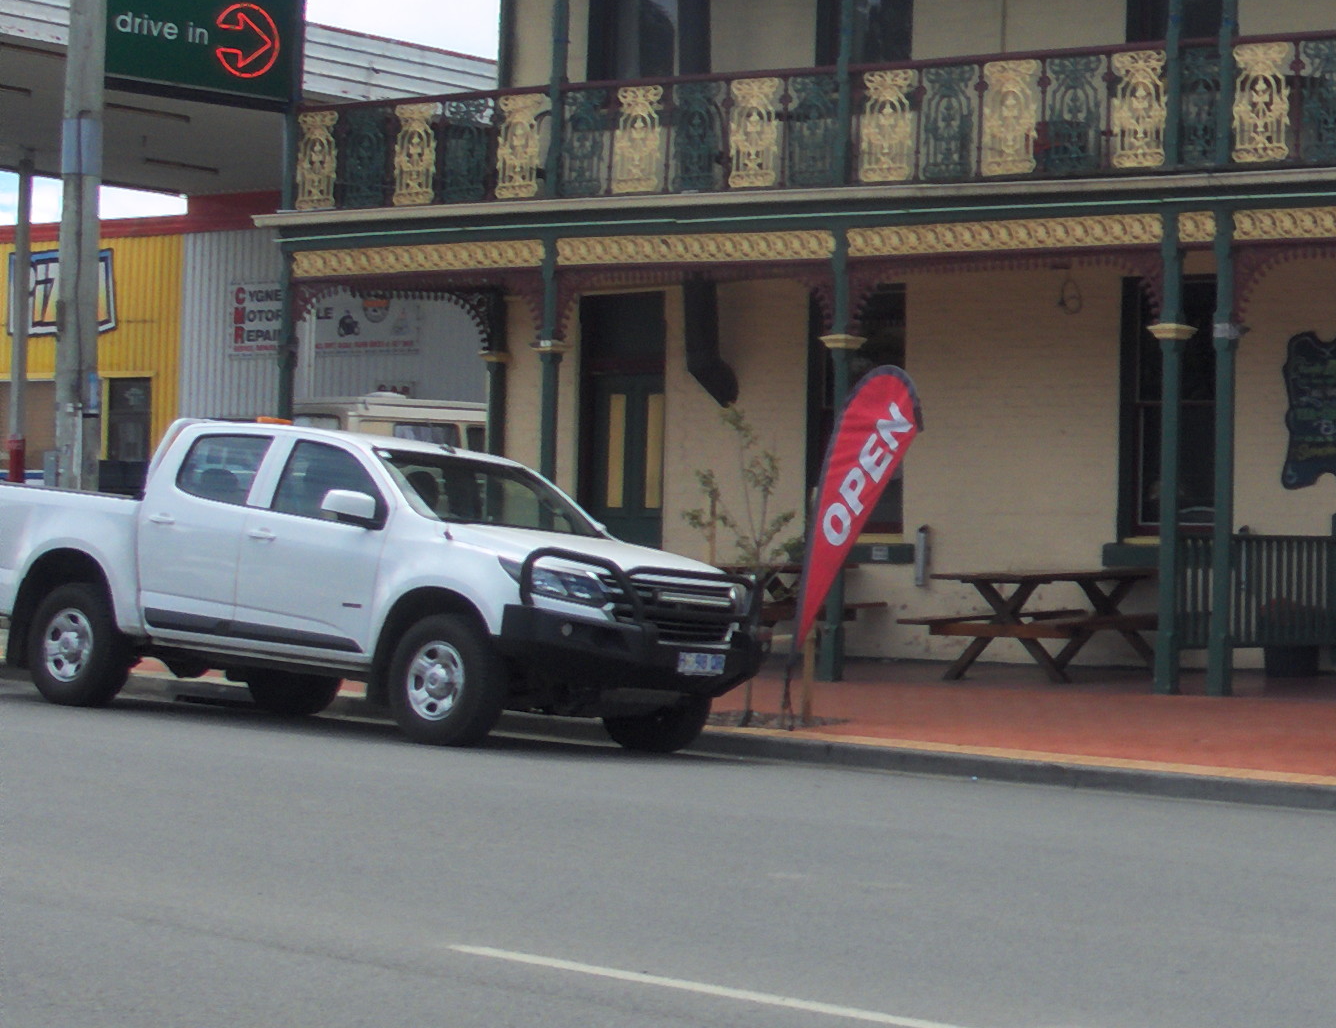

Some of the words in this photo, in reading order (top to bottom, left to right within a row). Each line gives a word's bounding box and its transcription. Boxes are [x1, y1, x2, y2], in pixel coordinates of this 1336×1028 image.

[115, 11, 178, 40] drive
[187, 22, 209, 45] in
[234, 286, 283, 306] CYGNE
[823, 402, 913, 546] OPEN
